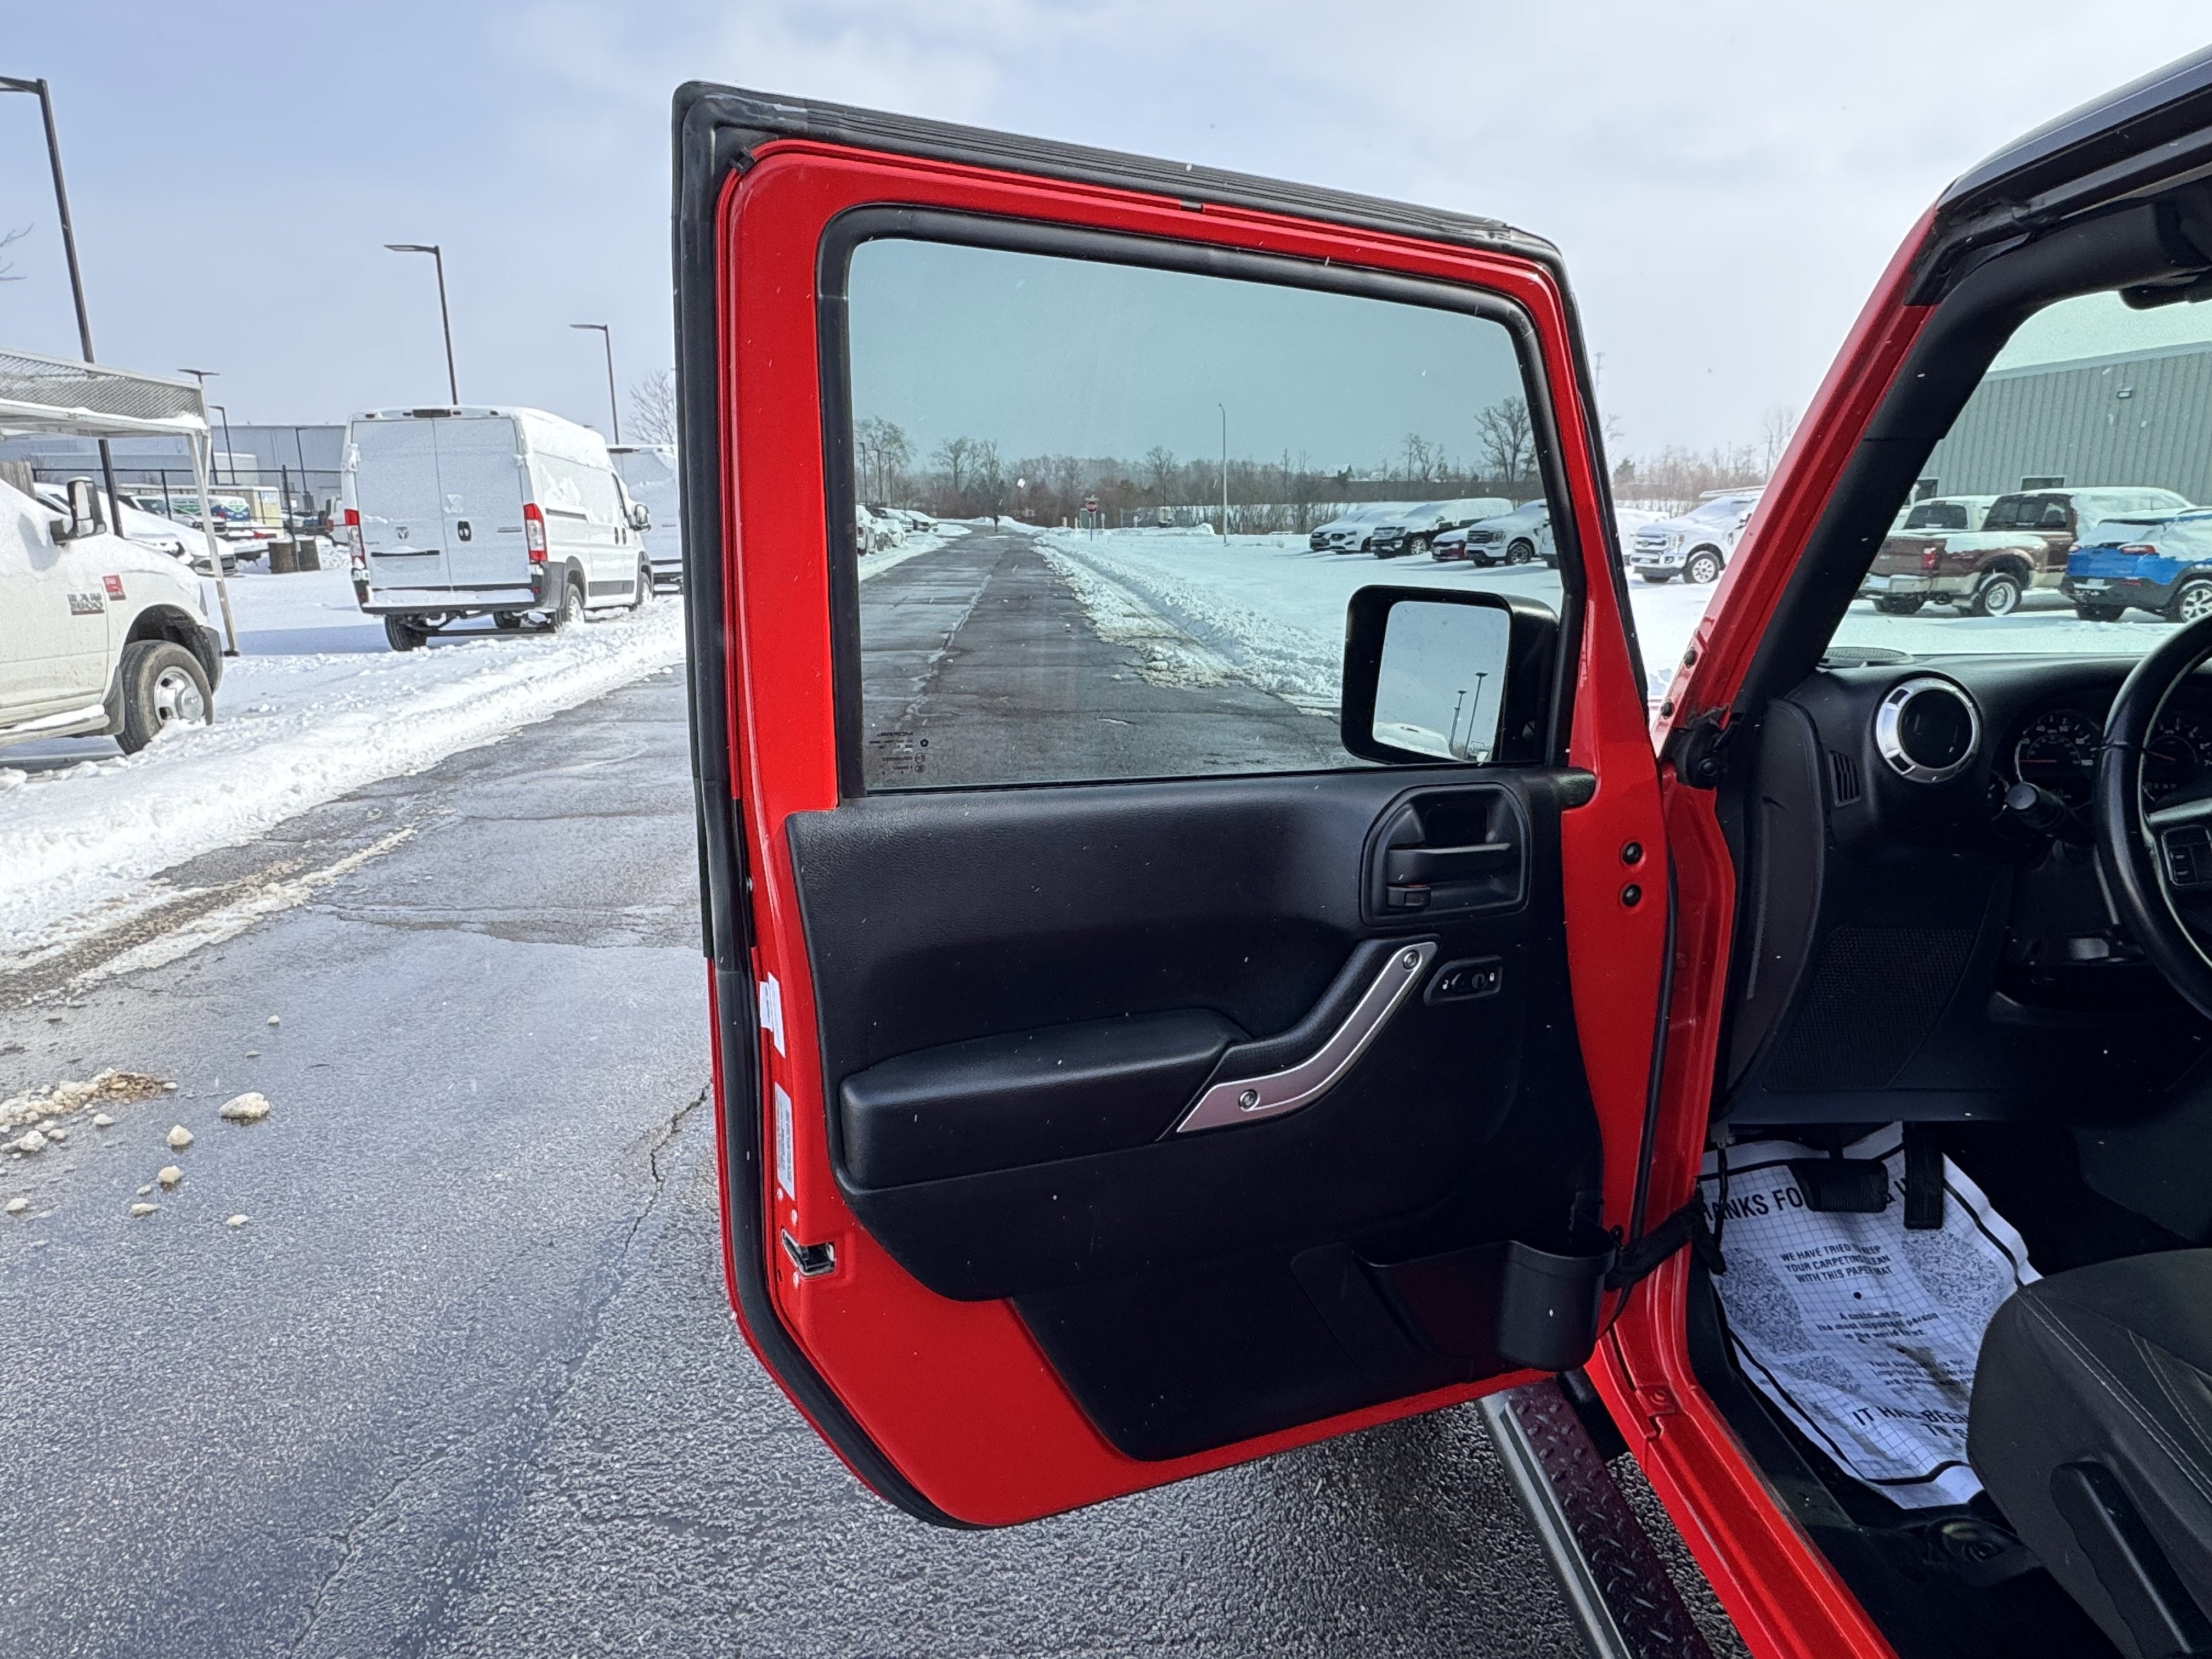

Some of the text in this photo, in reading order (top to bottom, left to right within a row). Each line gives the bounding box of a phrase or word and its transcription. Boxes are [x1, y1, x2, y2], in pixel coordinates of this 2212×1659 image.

[1702, 1187, 1804, 1221] HANKS FO
[1780, 1252, 1796, 1262] WE
[1797, 1247, 1822, 1260] HAVE
[1823, 1243, 1851, 1255] TRIED
[1785, 1262, 1812, 1273] YOUR
[1795, 1273, 1821, 1283] WITH
[1820, 1269, 1844, 1280] THIS
[1852, 1408, 1874, 1426] IT
